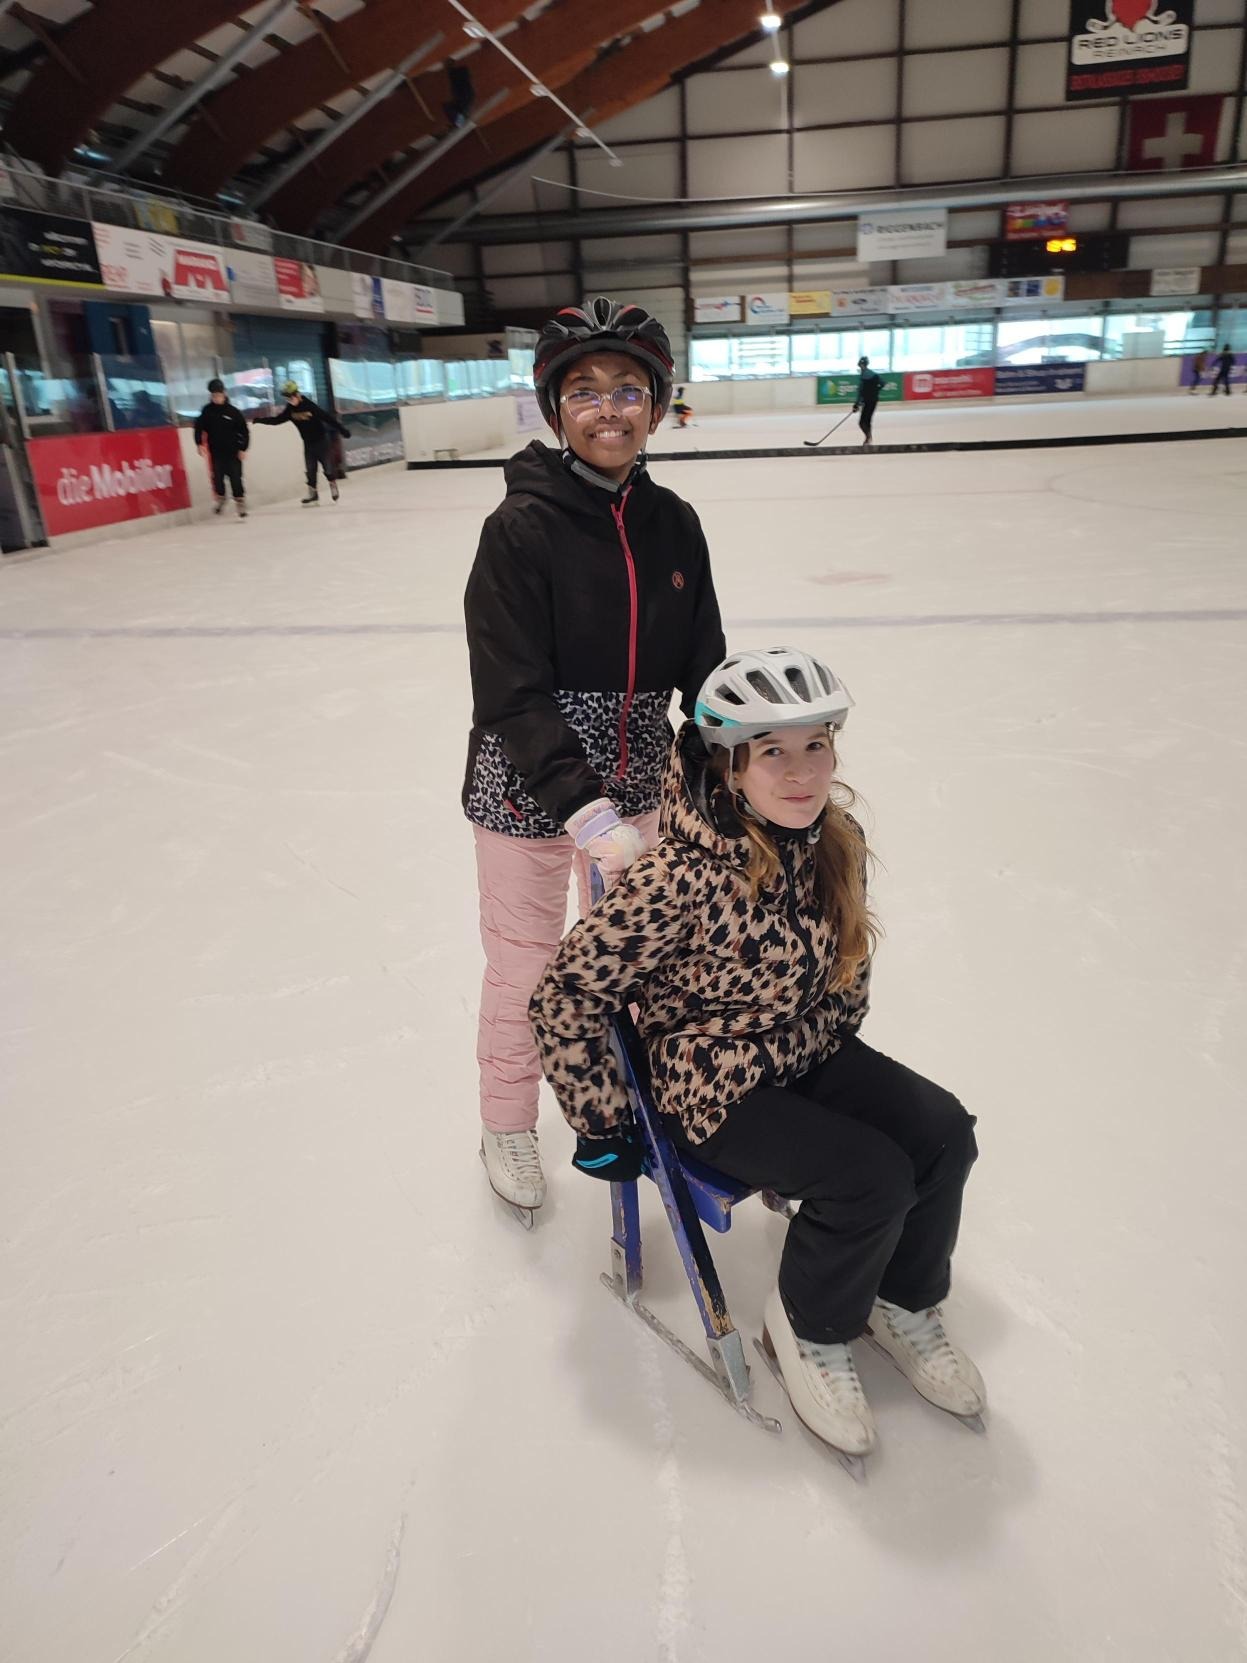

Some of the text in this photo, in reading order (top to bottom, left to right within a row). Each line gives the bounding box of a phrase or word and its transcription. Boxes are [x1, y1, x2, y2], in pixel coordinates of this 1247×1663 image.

[1079, 28, 1184, 49] RED LIONS
[57, 458, 174, 505] die Mobiliar
